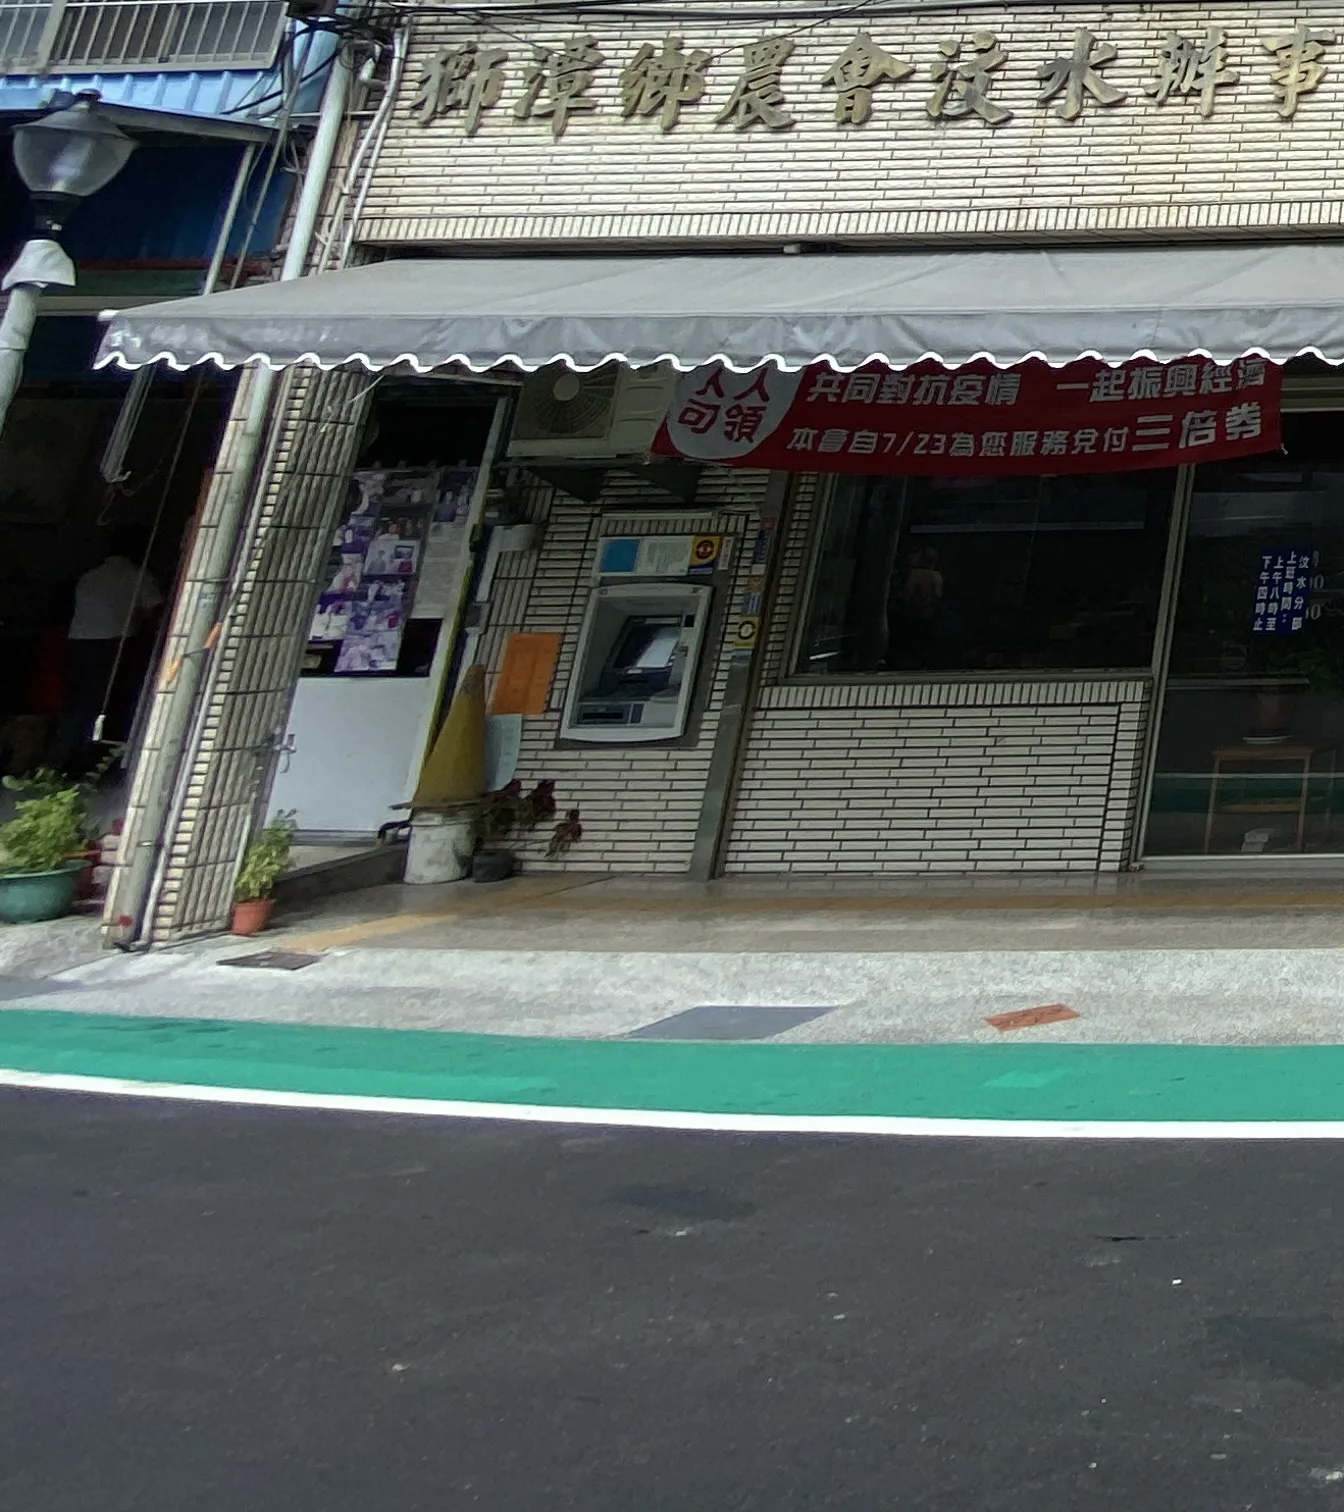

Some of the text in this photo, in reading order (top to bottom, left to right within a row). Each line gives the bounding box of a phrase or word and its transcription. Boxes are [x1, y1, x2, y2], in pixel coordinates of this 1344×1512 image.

[806, 359, 1267, 408] 共同對抗疫情 一起振興經濟
[677, 402, 765, 443] 可領
